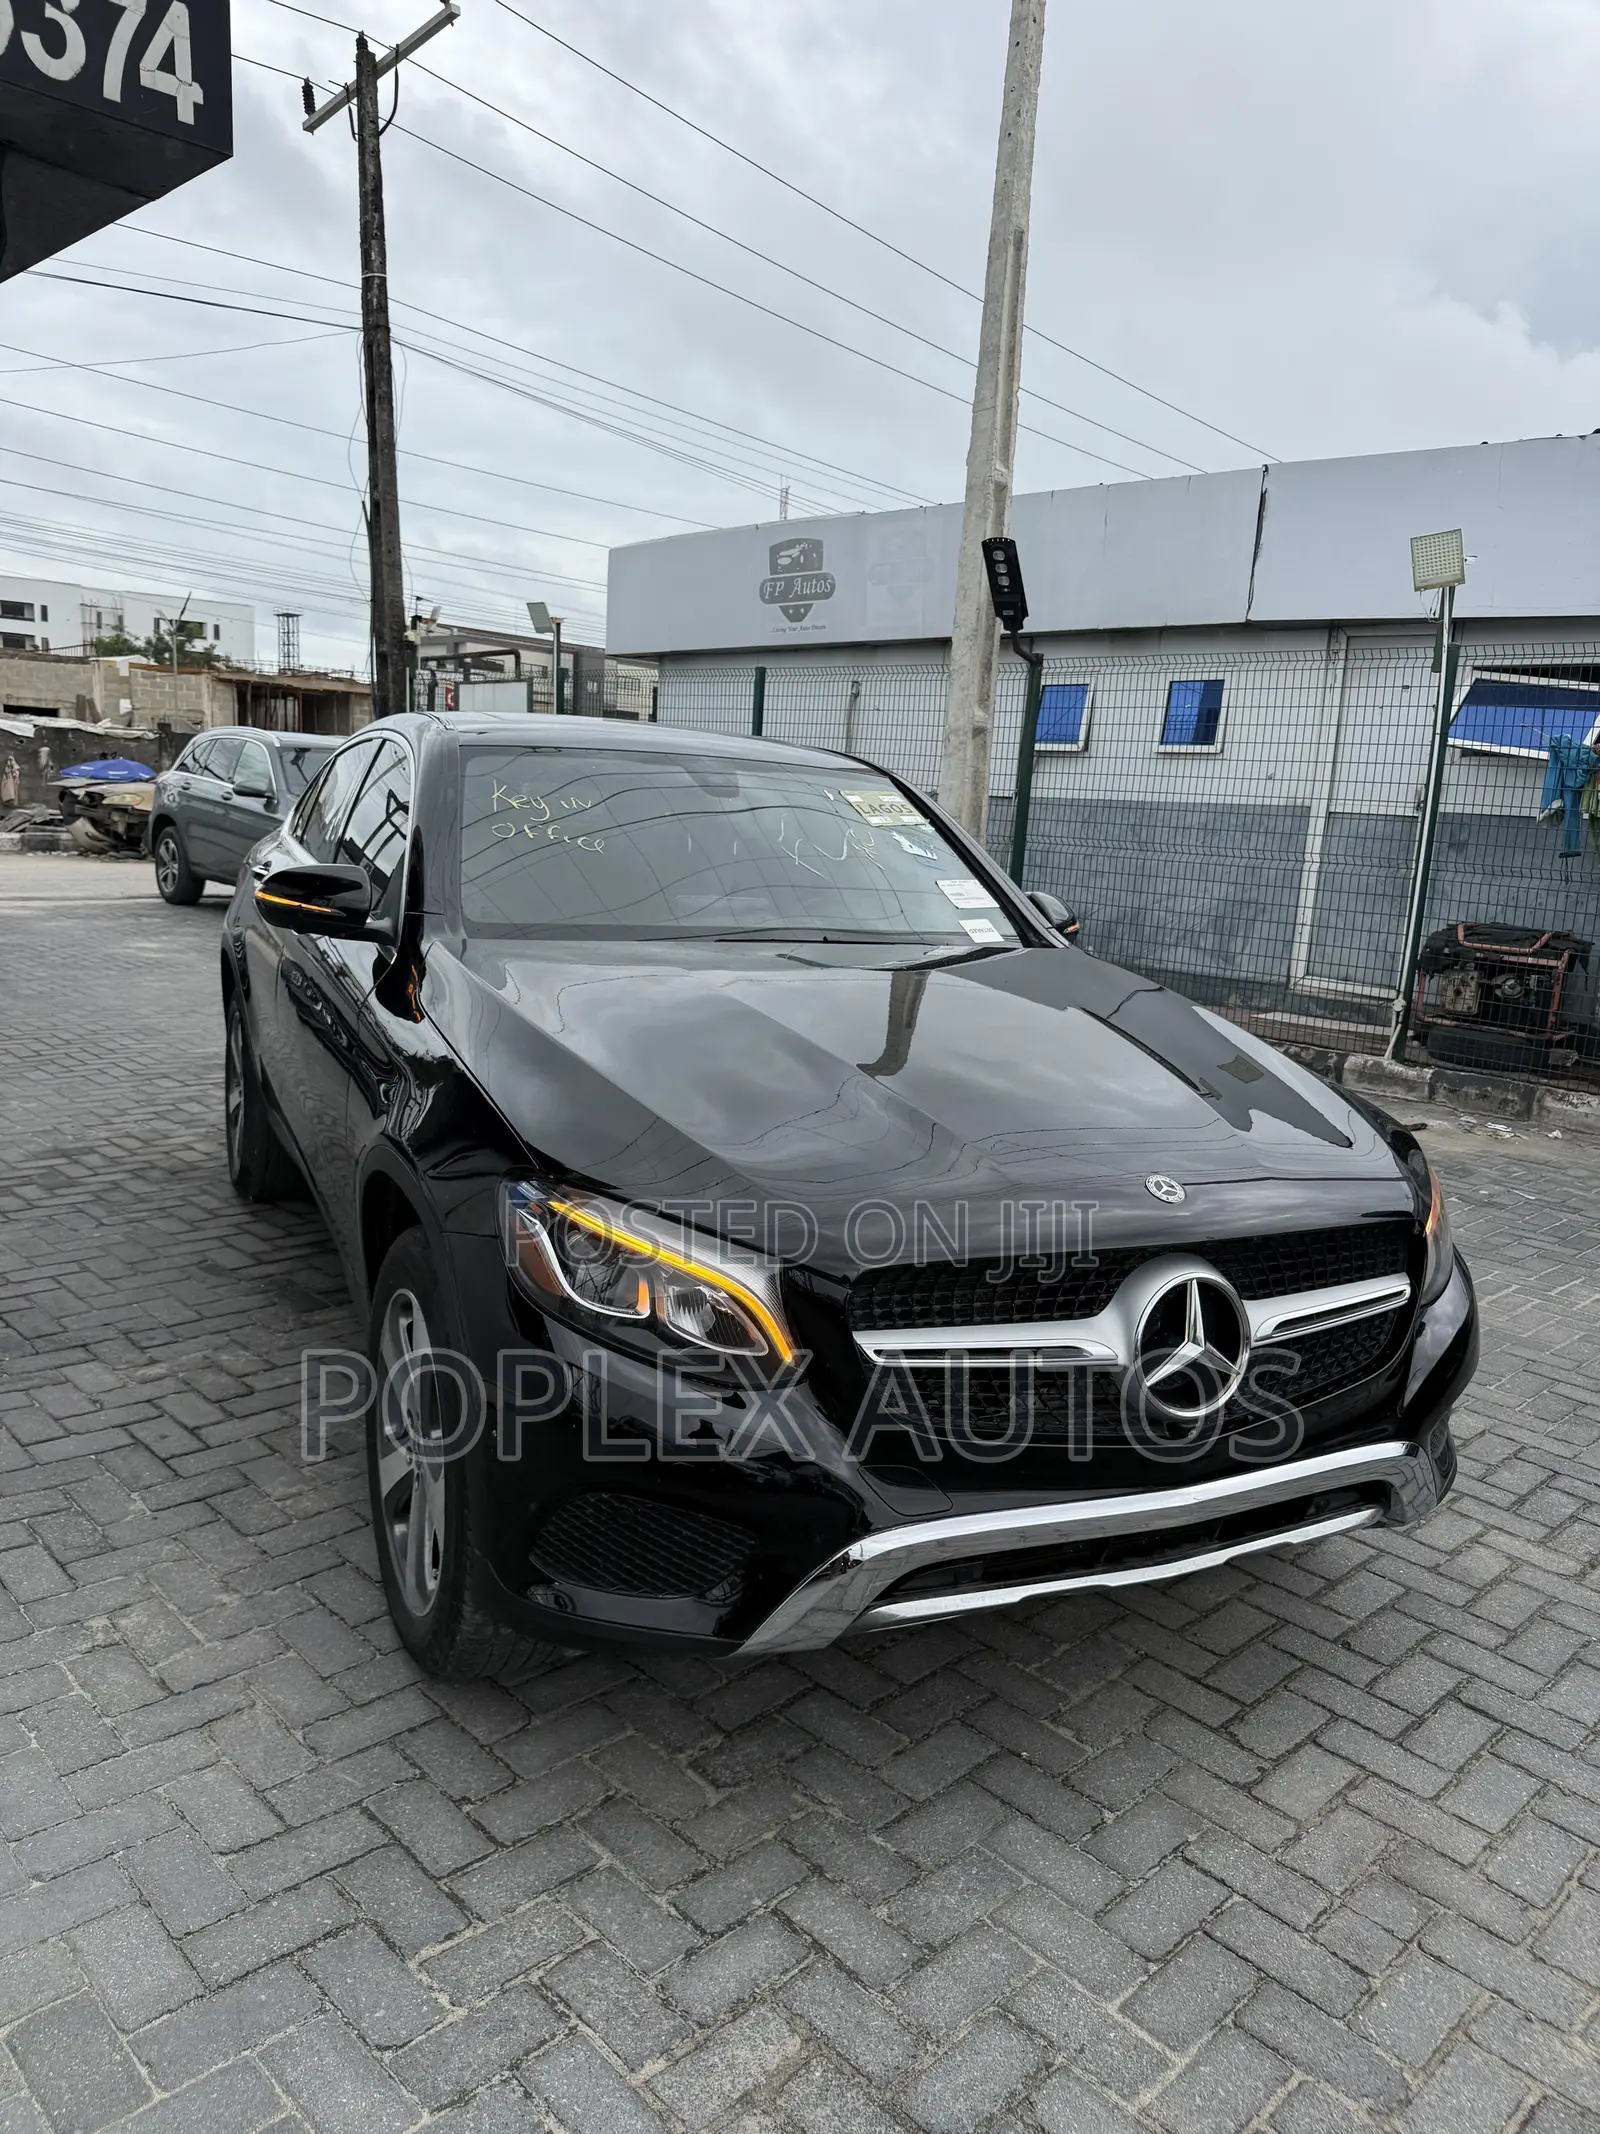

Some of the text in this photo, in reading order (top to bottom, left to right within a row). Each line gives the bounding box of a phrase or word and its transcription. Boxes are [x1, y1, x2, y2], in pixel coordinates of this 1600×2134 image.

[0, 0, 204, 125] 374
[763, 577, 832, 599] FP Autos
[492, 779, 551, 822] Key
[856, 803, 914, 814] LAGOS
